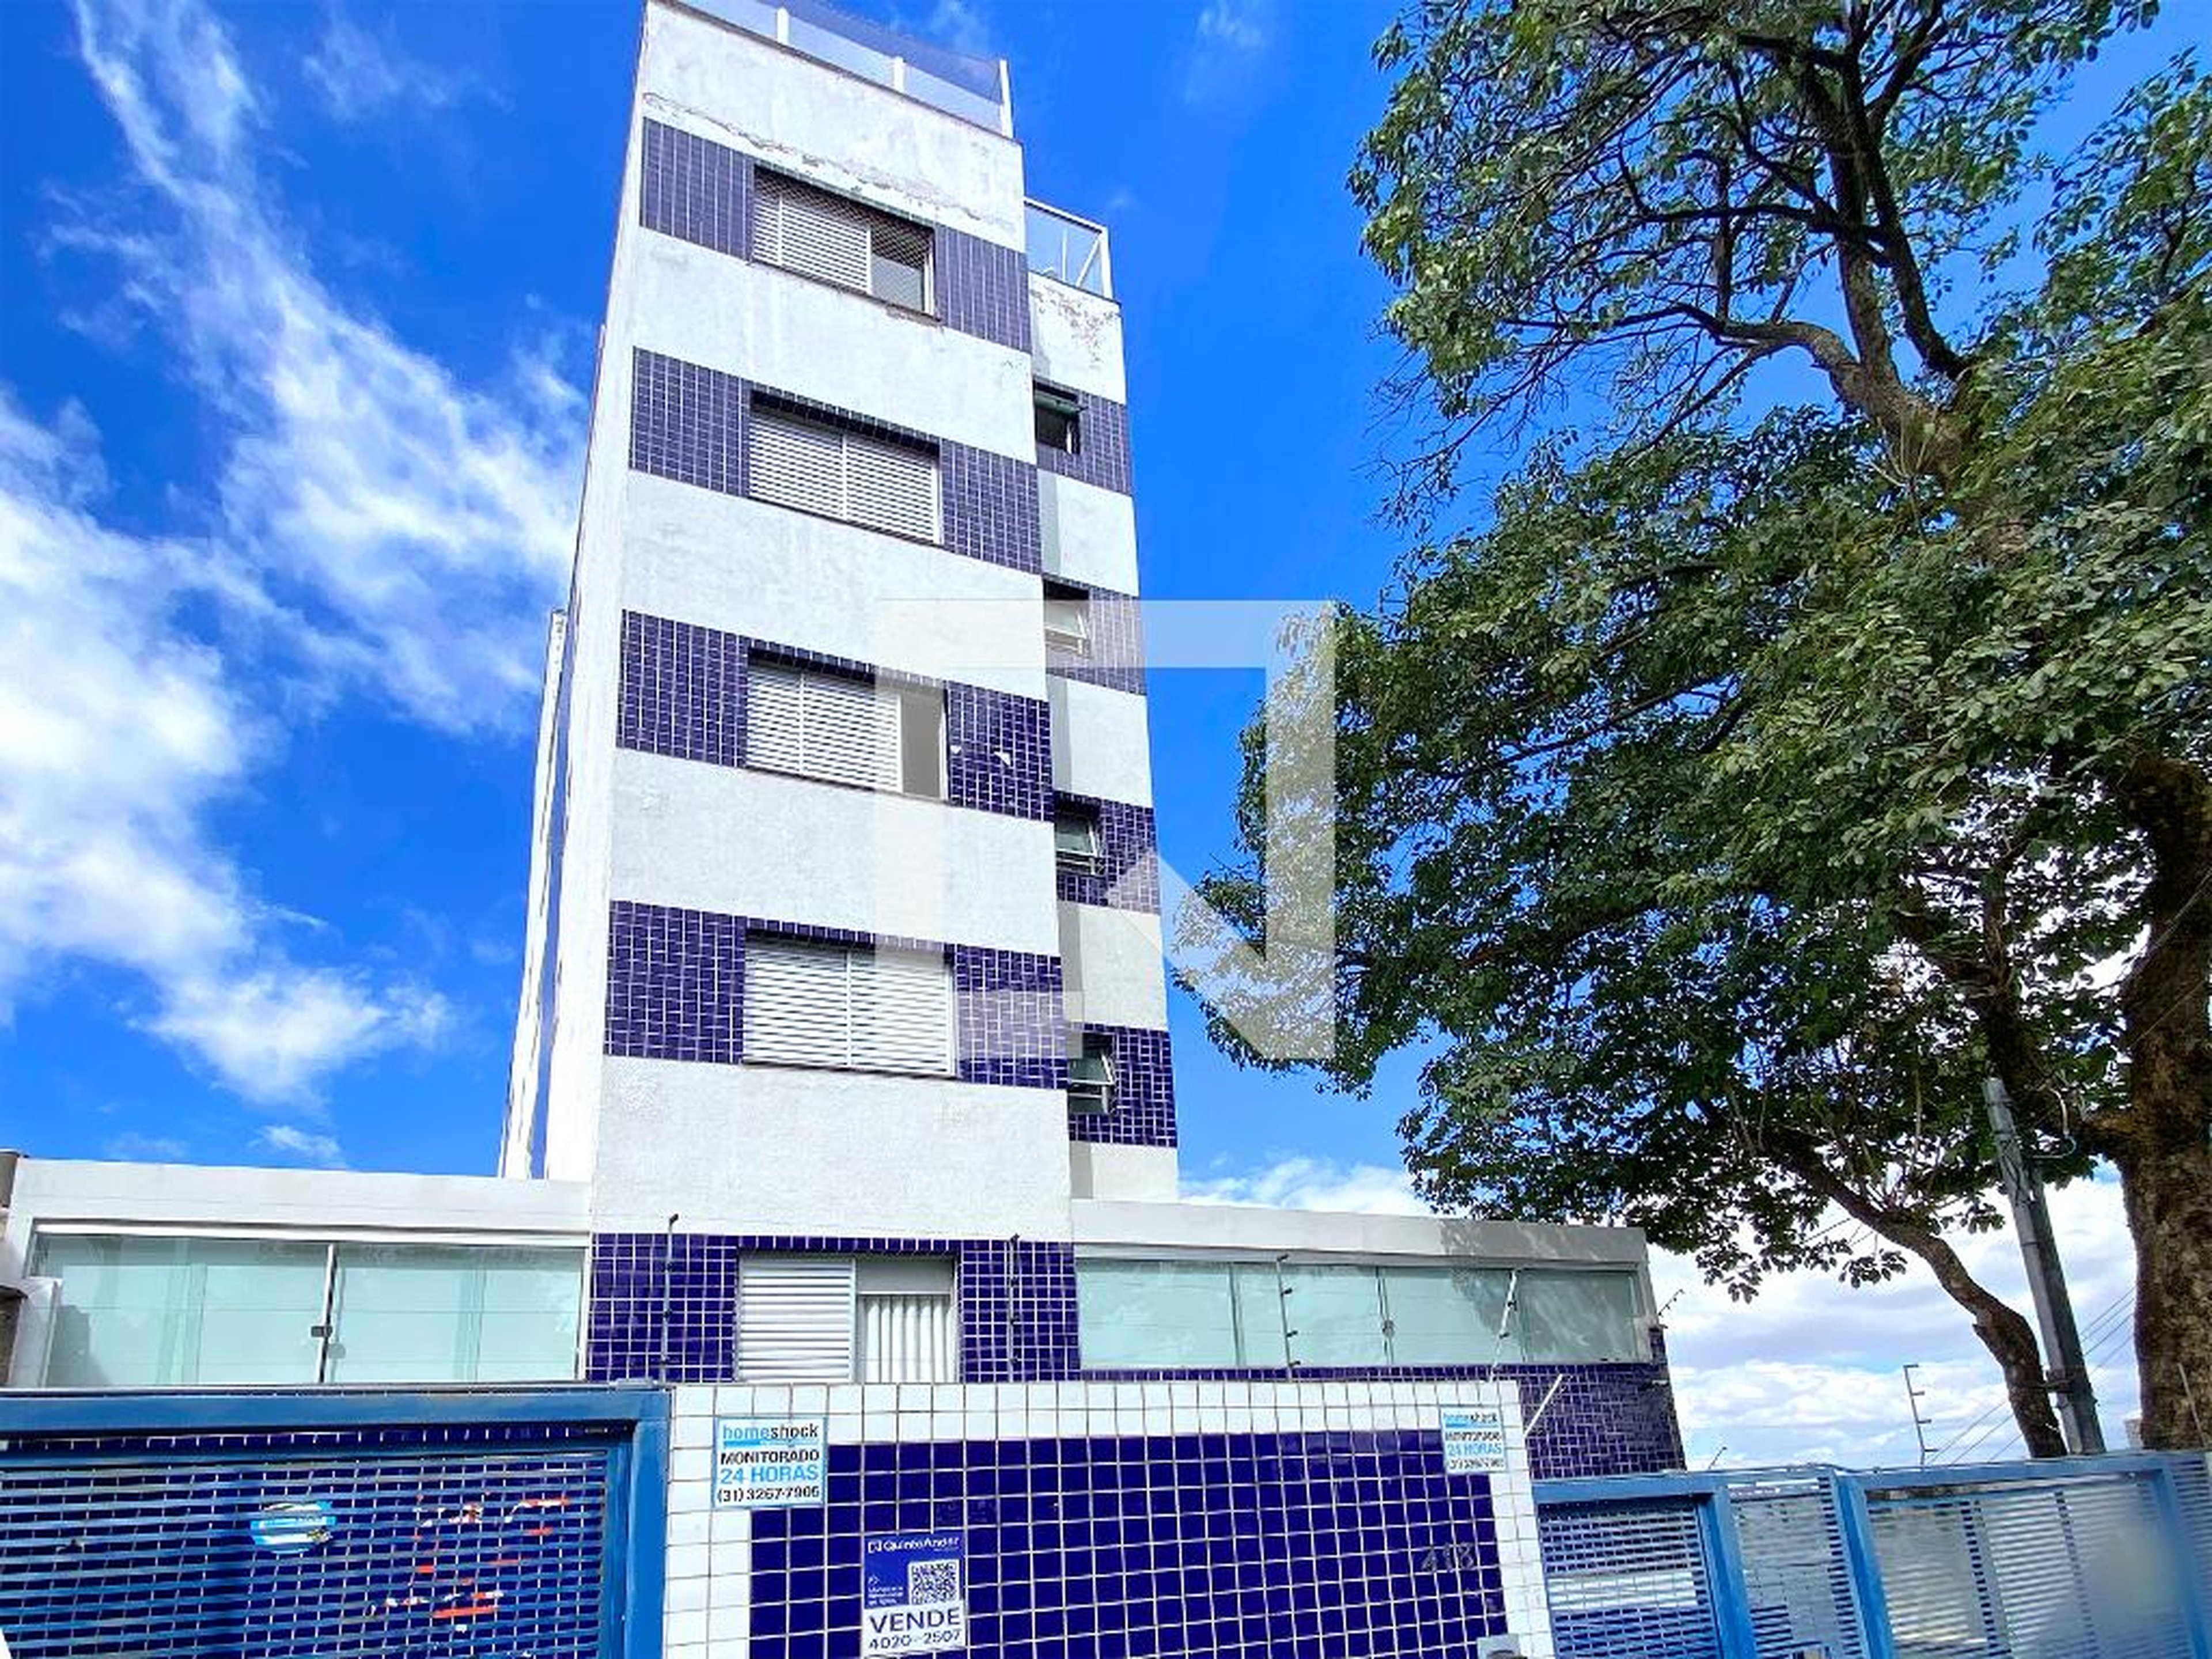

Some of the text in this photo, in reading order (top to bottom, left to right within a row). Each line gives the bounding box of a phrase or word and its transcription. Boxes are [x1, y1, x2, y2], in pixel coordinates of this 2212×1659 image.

[723, 1423, 819, 1439] homeshock
[721, 1449, 820, 1465] MONITORADO
[720, 1465, 819, 1484] 24 HORAS
[869, 1607, 960, 1633] VENDE
